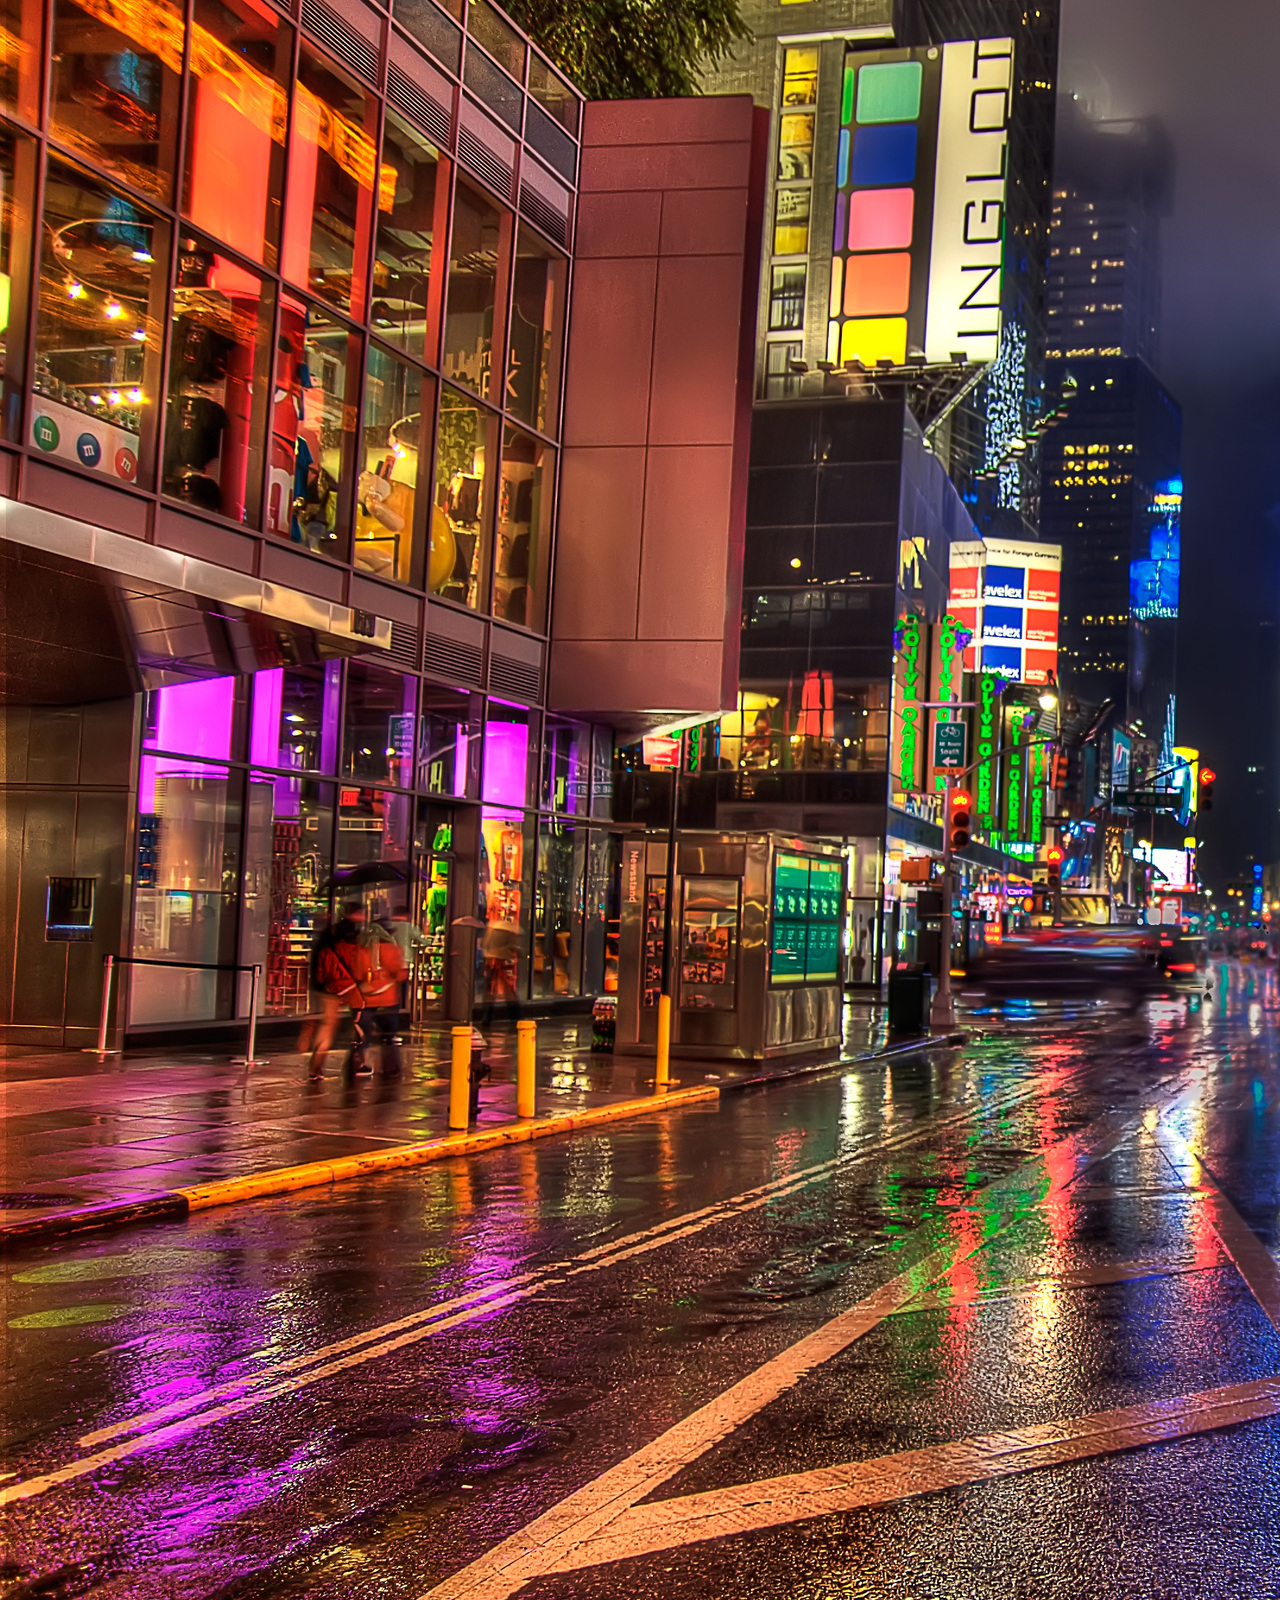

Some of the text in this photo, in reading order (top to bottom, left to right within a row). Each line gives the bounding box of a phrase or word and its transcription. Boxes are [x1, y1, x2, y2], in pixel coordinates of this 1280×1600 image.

[957, 38, 1013, 338] INGLOT
[1012, 550, 1034, 558] Foreign
[1034, 551, 1060, 560] Currency
[939, 631, 956, 701] OLIVE
[940, 747, 960, 755] South
[977, 678, 995, 815] OLIVE GRDEN
[1011, 715, 1023, 766] OLIE
[628, 850, 639, 903] Newsstand
